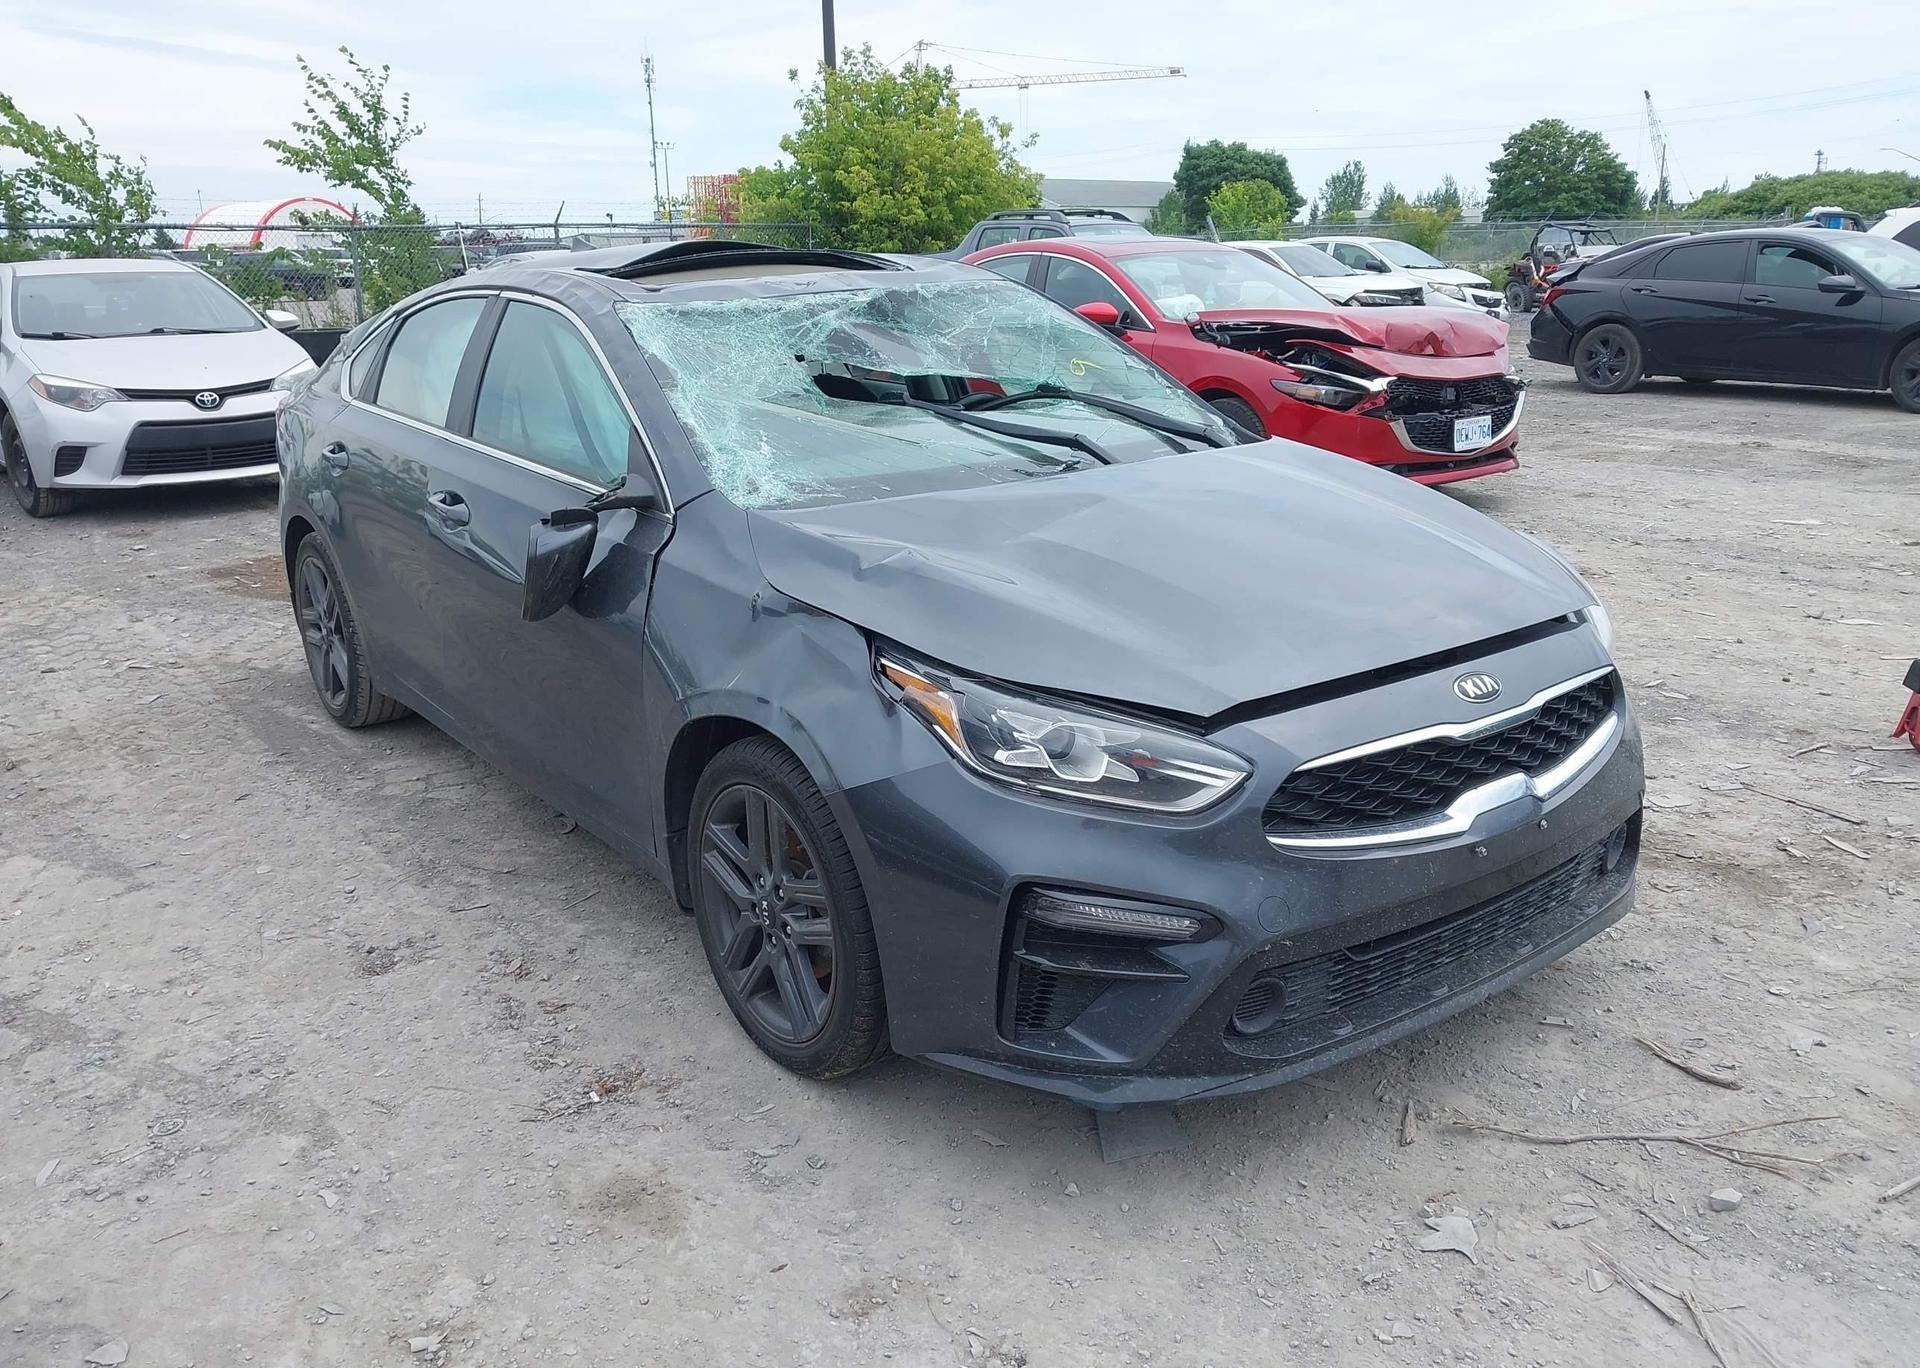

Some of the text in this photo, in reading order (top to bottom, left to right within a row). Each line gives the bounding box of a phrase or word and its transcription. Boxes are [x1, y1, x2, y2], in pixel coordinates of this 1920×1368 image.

[1478, 423, 1491, 440] 764
[1459, 675, 1499, 698] KIA
[761, 900, 770, 926] KIA
